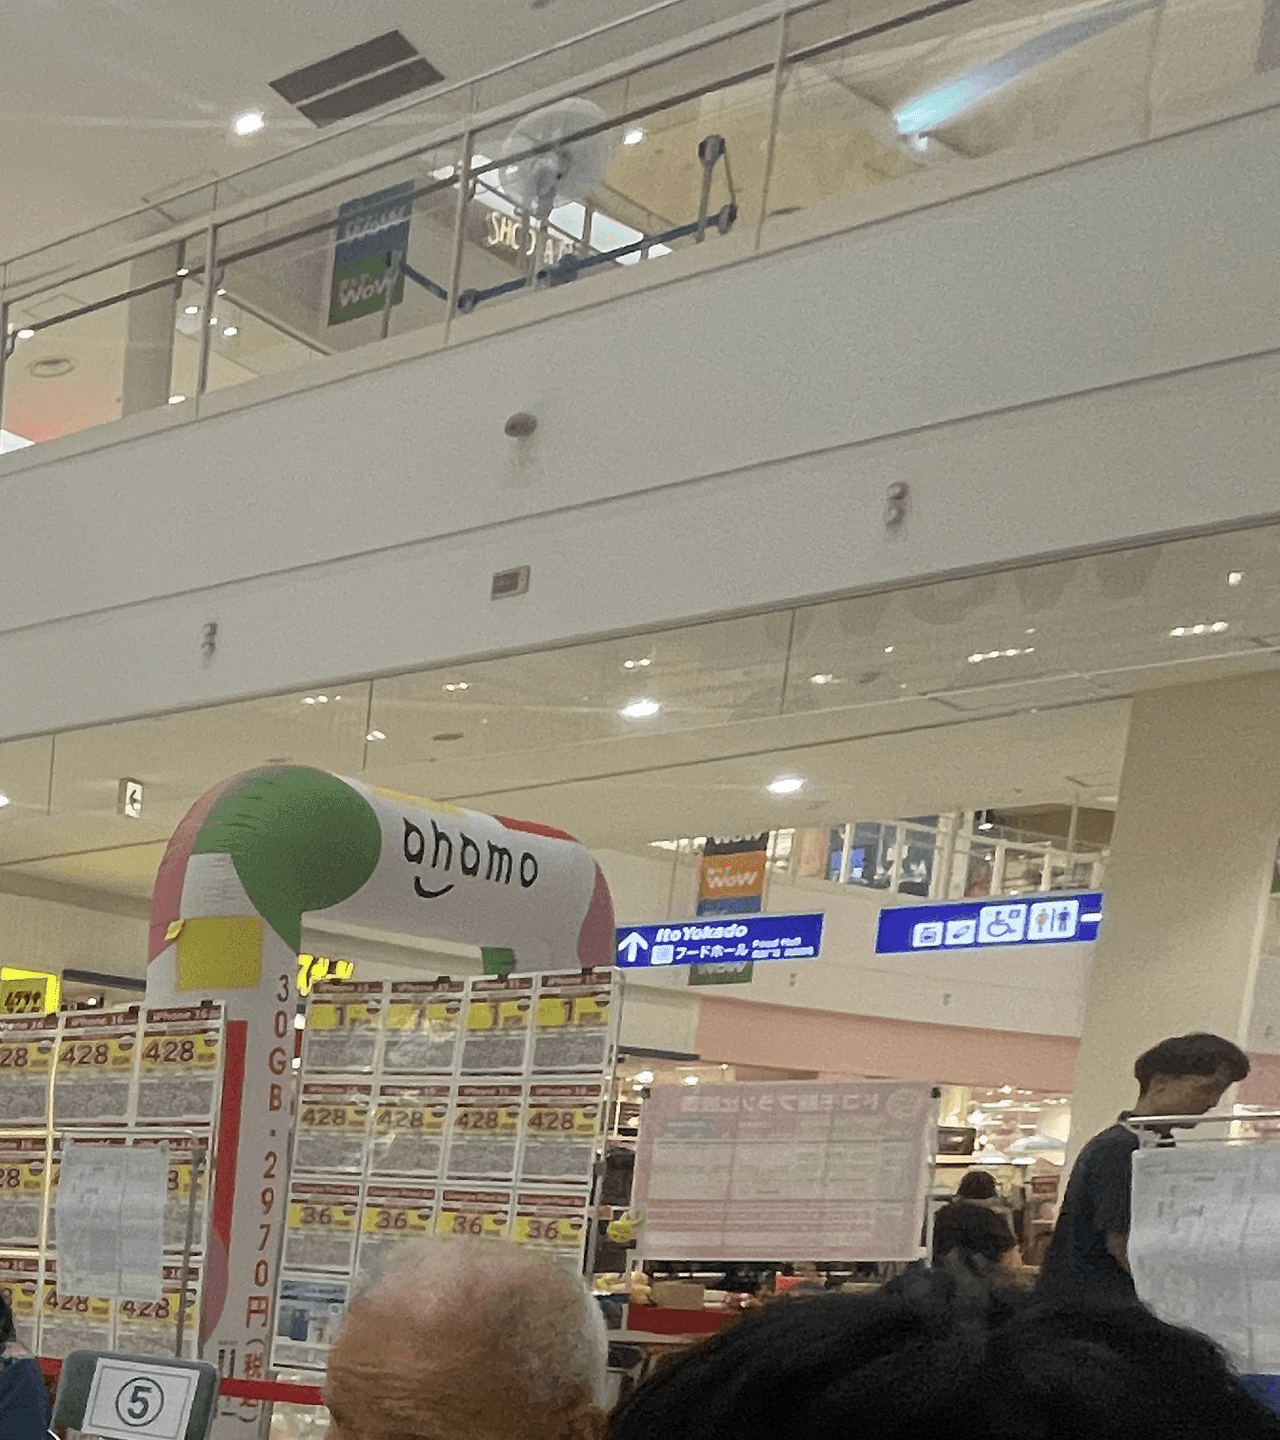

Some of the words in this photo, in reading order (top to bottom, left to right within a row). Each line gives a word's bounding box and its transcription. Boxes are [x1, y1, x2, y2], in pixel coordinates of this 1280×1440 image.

[403, 816, 538, 888] ahamo
[59, 1043, 108, 1065] 428
[144, 1040, 195, 1063] 428
[301, 1109, 346, 1126] 428
[376, 1110, 424, 1128] 428
[454, 1112, 499, 1128] 428
[528, 1113, 575, 1130] 428
[301, 1206, 332, 1225] 36
[376, 1211, 408, 1229] 36
[452, 1216, 482, 1235] 36
[528, 1220, 559, 1239] 36
[44, 1292, 89, 1313] 428
[122, 1298, 170, 1319] 428
